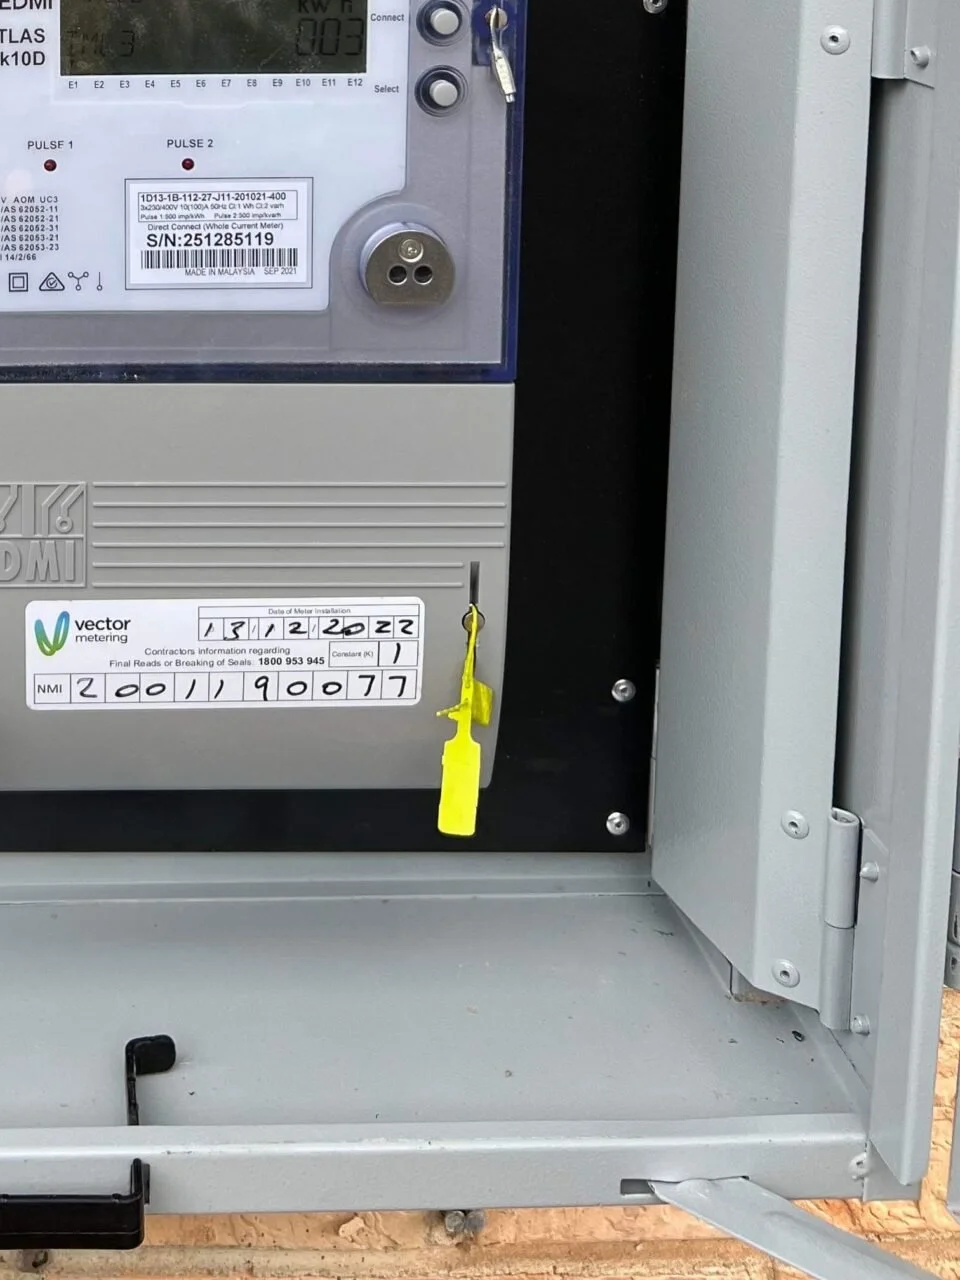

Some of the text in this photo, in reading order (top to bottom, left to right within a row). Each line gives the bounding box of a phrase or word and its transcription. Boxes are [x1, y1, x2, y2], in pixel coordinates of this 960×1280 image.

[370, 13, 405, 23] Connect
[68, 78, 363, 89] E1 E2 E3 E4 E5 E6 E7 E8 E9 E10 E11 E12
[374, 84, 400, 94] Select
[27, 140, 74, 150] PULSE 1
[167, 138, 214, 149] PULSE 2
[13, 196, 35, 204] AOM
[39, 195, 59, 204] UC3
[18, 205, 59, 213] 62052-11
[18, 215, 59, 223] 62052-21
[147, 222, 284, 231] Direct Connect (Whole Current Meter)
[146, 232, 274, 248] S/N:251285119
[185, 267, 297, 276] MADE IN MALAYSIA SEP 2021
[74, 616, 130, 631] vector
[75, 632, 128, 645] metering
[144, 646, 291, 657] Contractors information regarding
[109, 659, 132, 668] Final
[134, 659, 161, 668] Reads
[174, 658, 214, 670] Breaking
[216, 658, 225, 667] of
[258, 657, 283, 666] 1800
[286, 657, 304, 666] 953
[306, 656, 325, 665] 945
[37, 684, 63, 694] NMI
